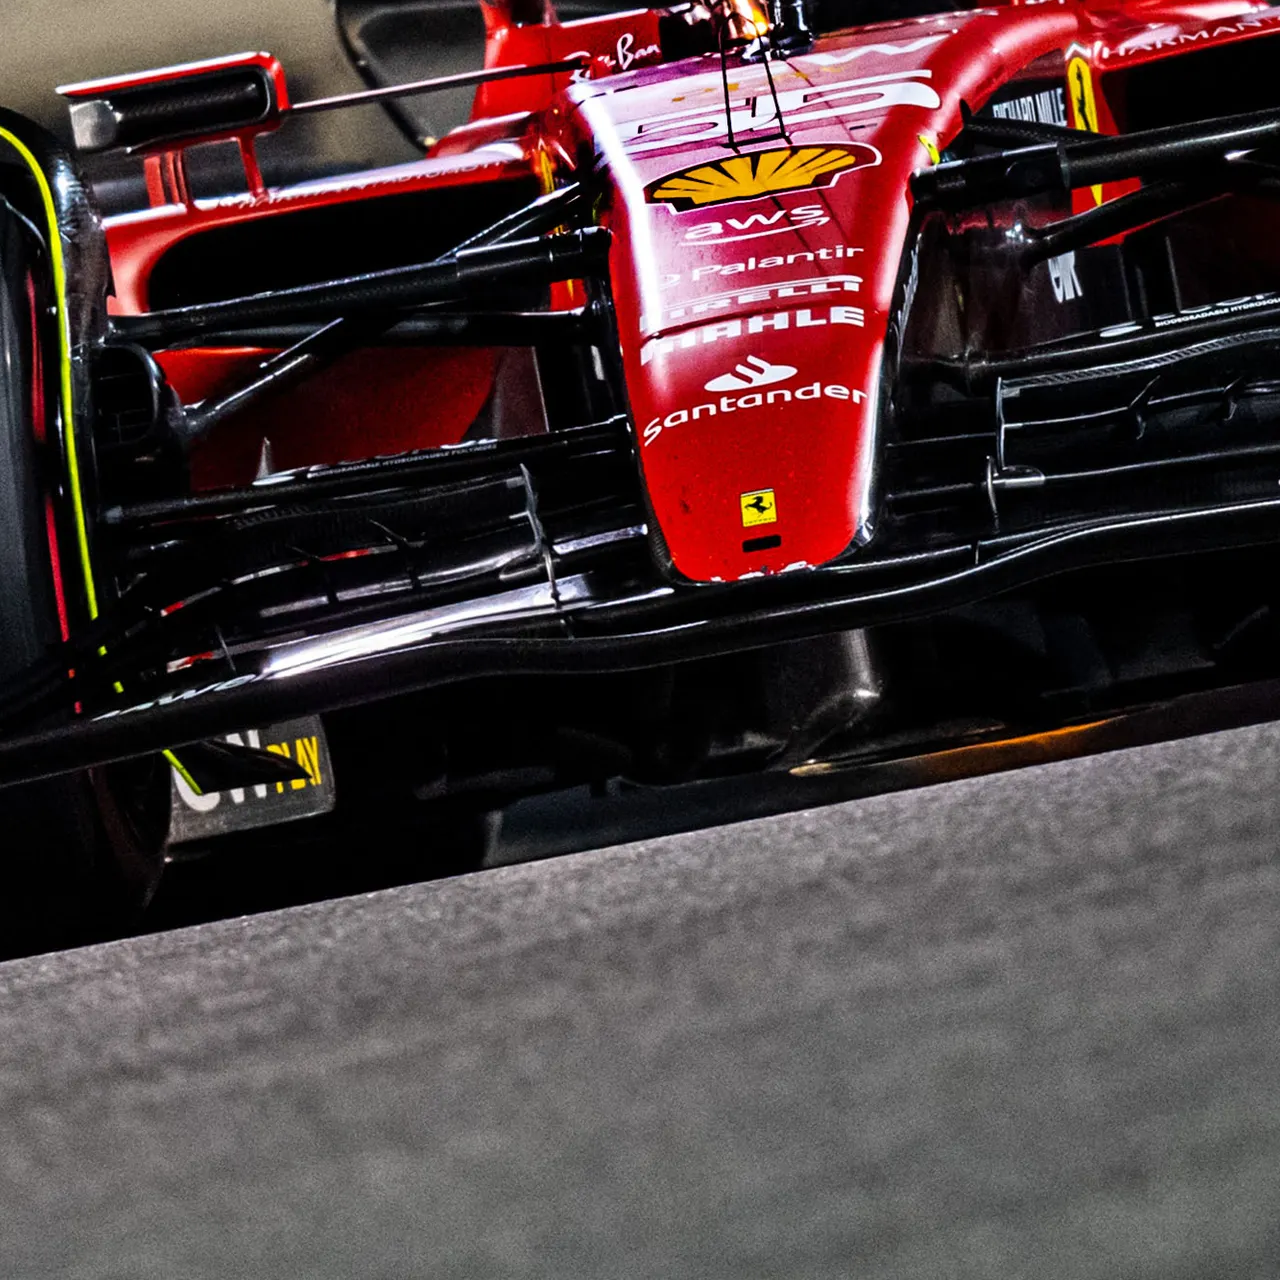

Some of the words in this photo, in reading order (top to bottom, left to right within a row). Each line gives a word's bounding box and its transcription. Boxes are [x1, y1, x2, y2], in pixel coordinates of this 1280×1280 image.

[613, 69, 941, 154] 55
[683, 204, 825, 242] aws
[692, 244, 865, 282] Palantir
[640, 305, 865, 366] MAHLE
[642, 381, 869, 448] Santander
